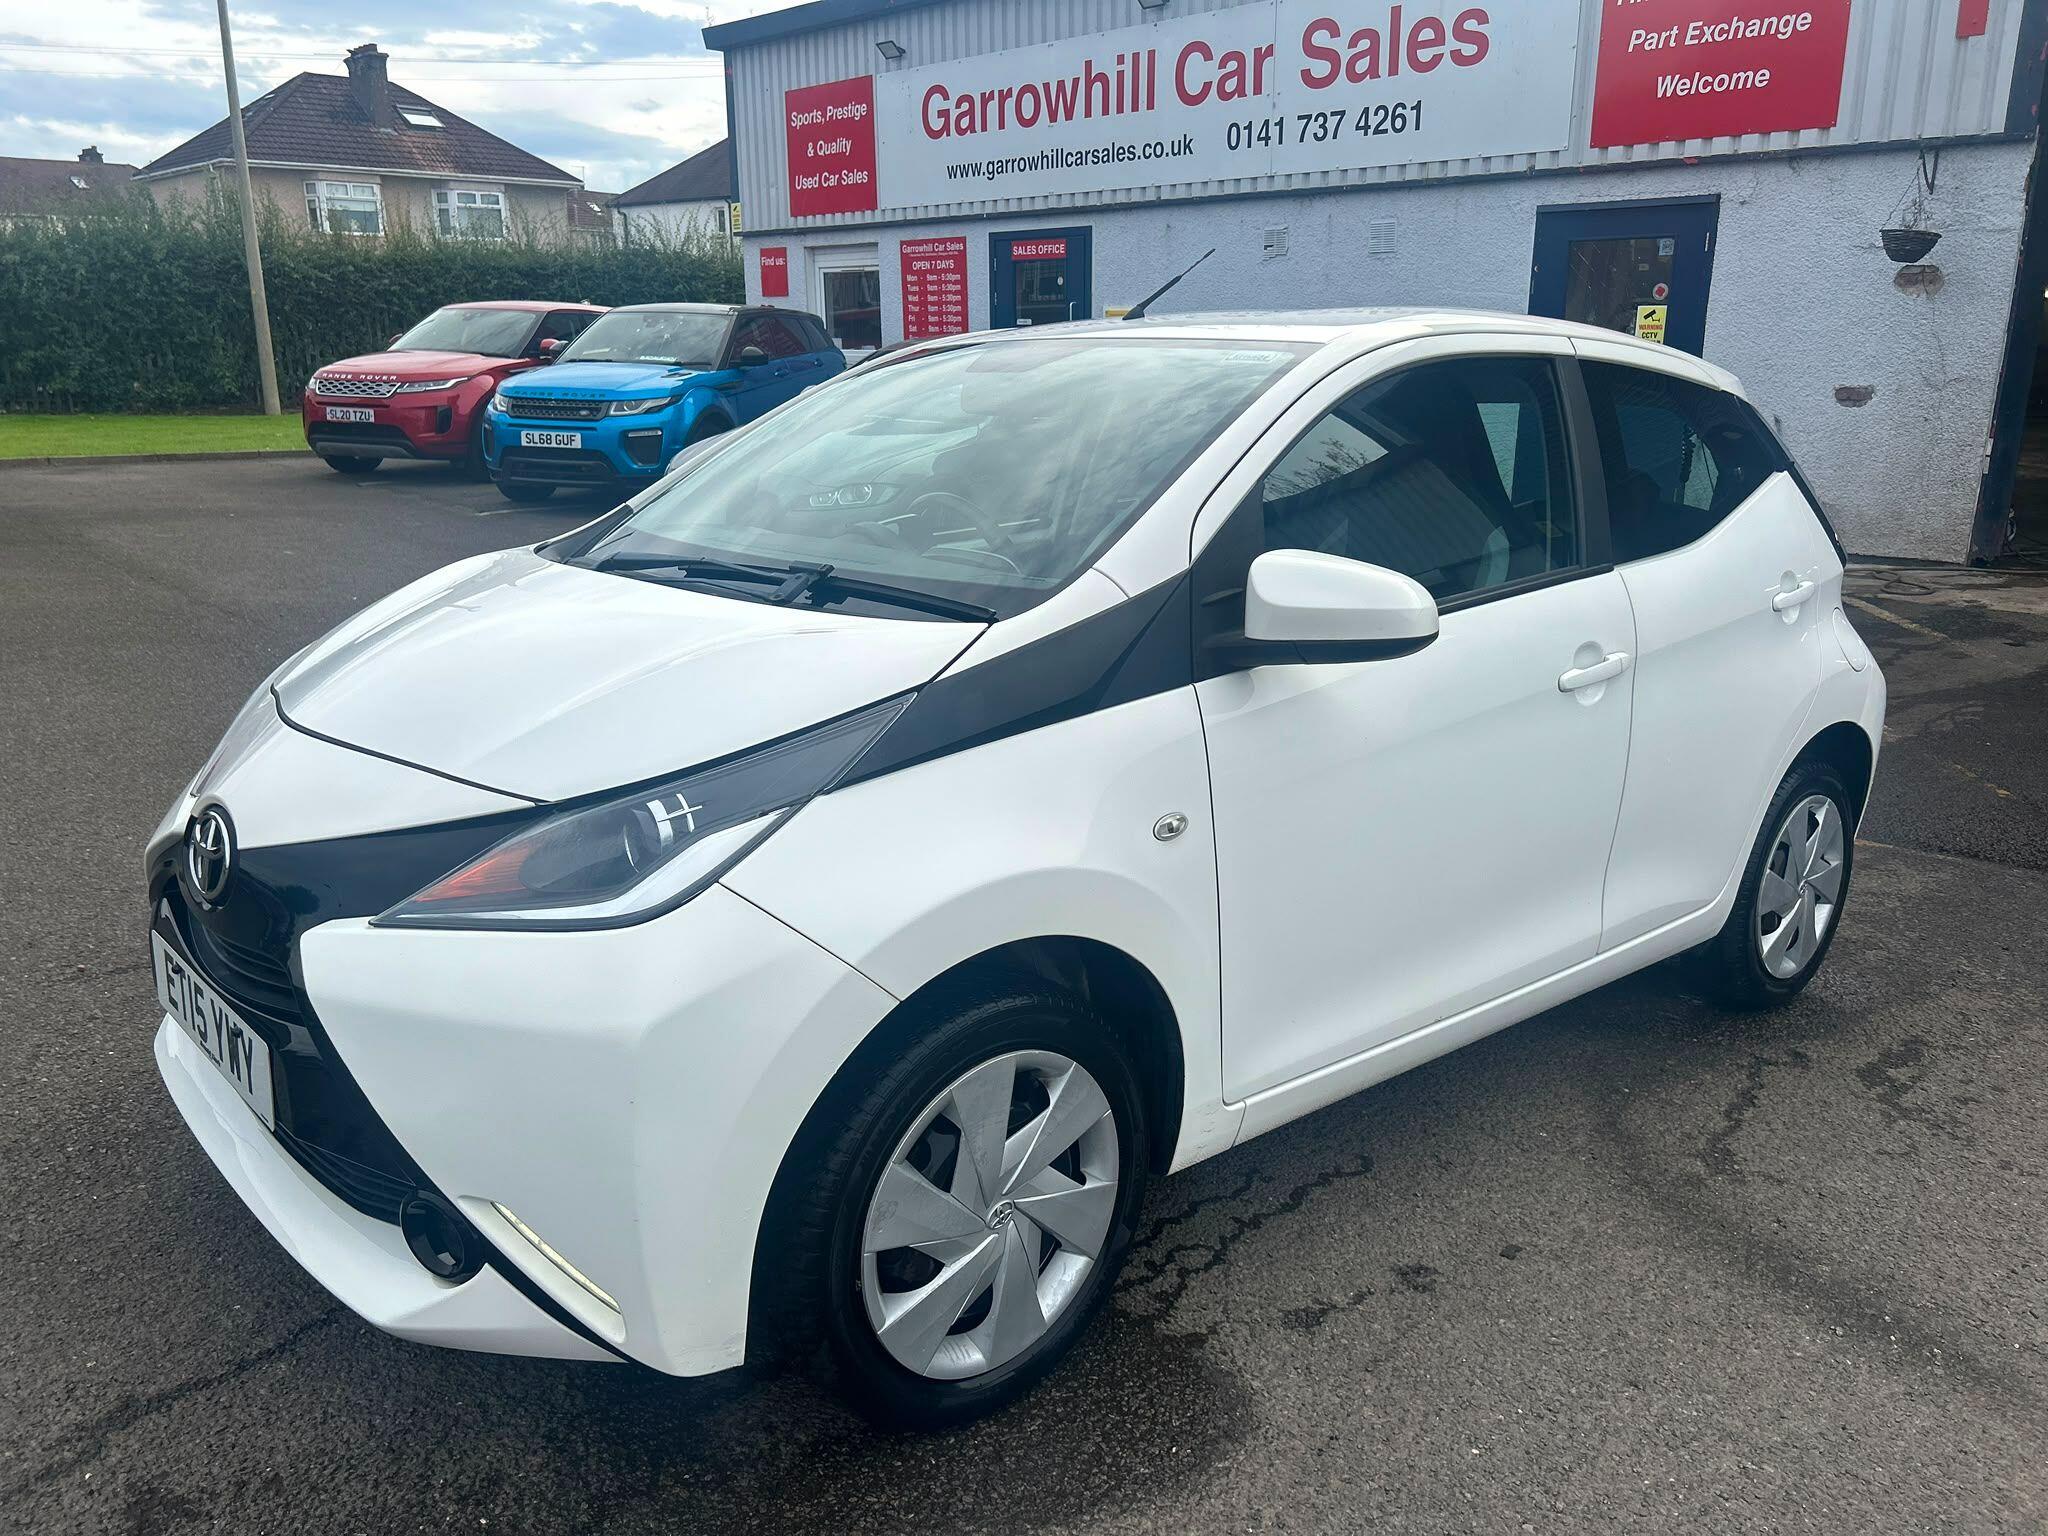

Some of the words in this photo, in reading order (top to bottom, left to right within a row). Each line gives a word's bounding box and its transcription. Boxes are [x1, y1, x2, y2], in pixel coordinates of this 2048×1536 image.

[1627, 25, 1679, 53] Part
[1684, 11, 1812, 46] Exchange
[921, 48, 1156, 141] Garrowhill
[1174, 40, 1274, 107] Car
[1299, 4, 1490, 90] Sales
[1656, 68, 1771, 98] Welcome
[791, 109, 825, 129] Sports,
[826, 102, 867, 121] Prestige
[1226, 116, 1285, 151] 0141
[1297, 109, 1347, 143] 737
[1354, 100, 1422, 137] 4261
[807, 142, 814, 157] &
[816, 138, 851, 156] Quality
[947, 133, 1194, 181] www.garrowhillcarsales.co.uk
[795, 174, 819, 190] Used
[821, 172, 838, 187] Car
[841, 169, 868, 185] Sales
[902, 243, 933, 253] Garrowhill
[933, 243, 945, 251] Car
[946, 241, 963, 251] Sales
[1012, 245, 1036, 256] SALES
[1037, 244, 1065, 255] OFFICE
[761, 256, 774, 266] Find
[775, 257, 786, 266] us:
[912, 261, 930, 270] OPEN
[931, 261, 935, 269] 7
[936, 260, 954, 269] DAYS
[329, 408, 351, 420] SL20
[352, 408, 371, 421] TZU
[525, 432, 552, 445] SL68
[555, 434, 577, 446] GUF
[164, 949, 208, 1043] ET15
[210, 998, 253, 1095] YWY
